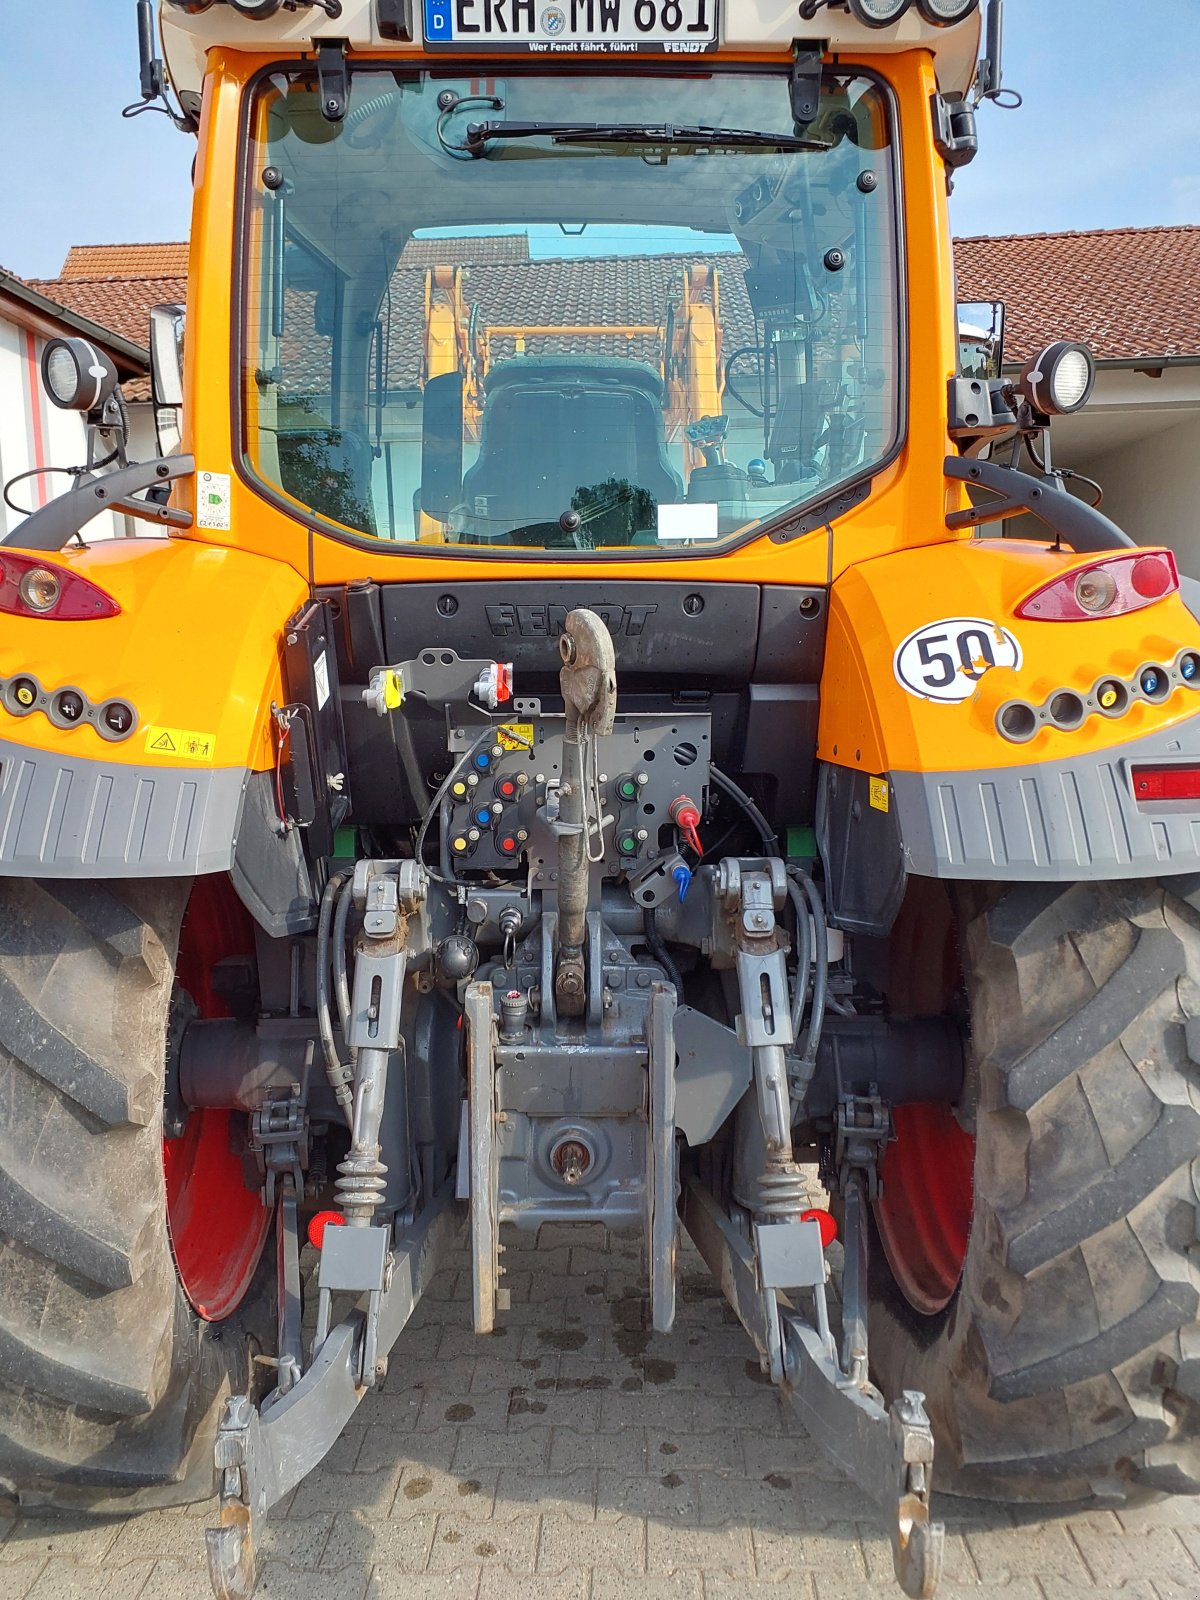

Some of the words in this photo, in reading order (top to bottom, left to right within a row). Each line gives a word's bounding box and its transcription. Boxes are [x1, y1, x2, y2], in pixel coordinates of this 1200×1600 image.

[433, 14, 445, 29] D
[528, 42, 548, 51] Wer
[550, 42, 578, 51] Fendt
[580, 42, 607, 53] fährt,
[609, 42, 638, 51] führt!
[663, 42, 709, 53] FENDT
[916, 629, 996, 688] 50
